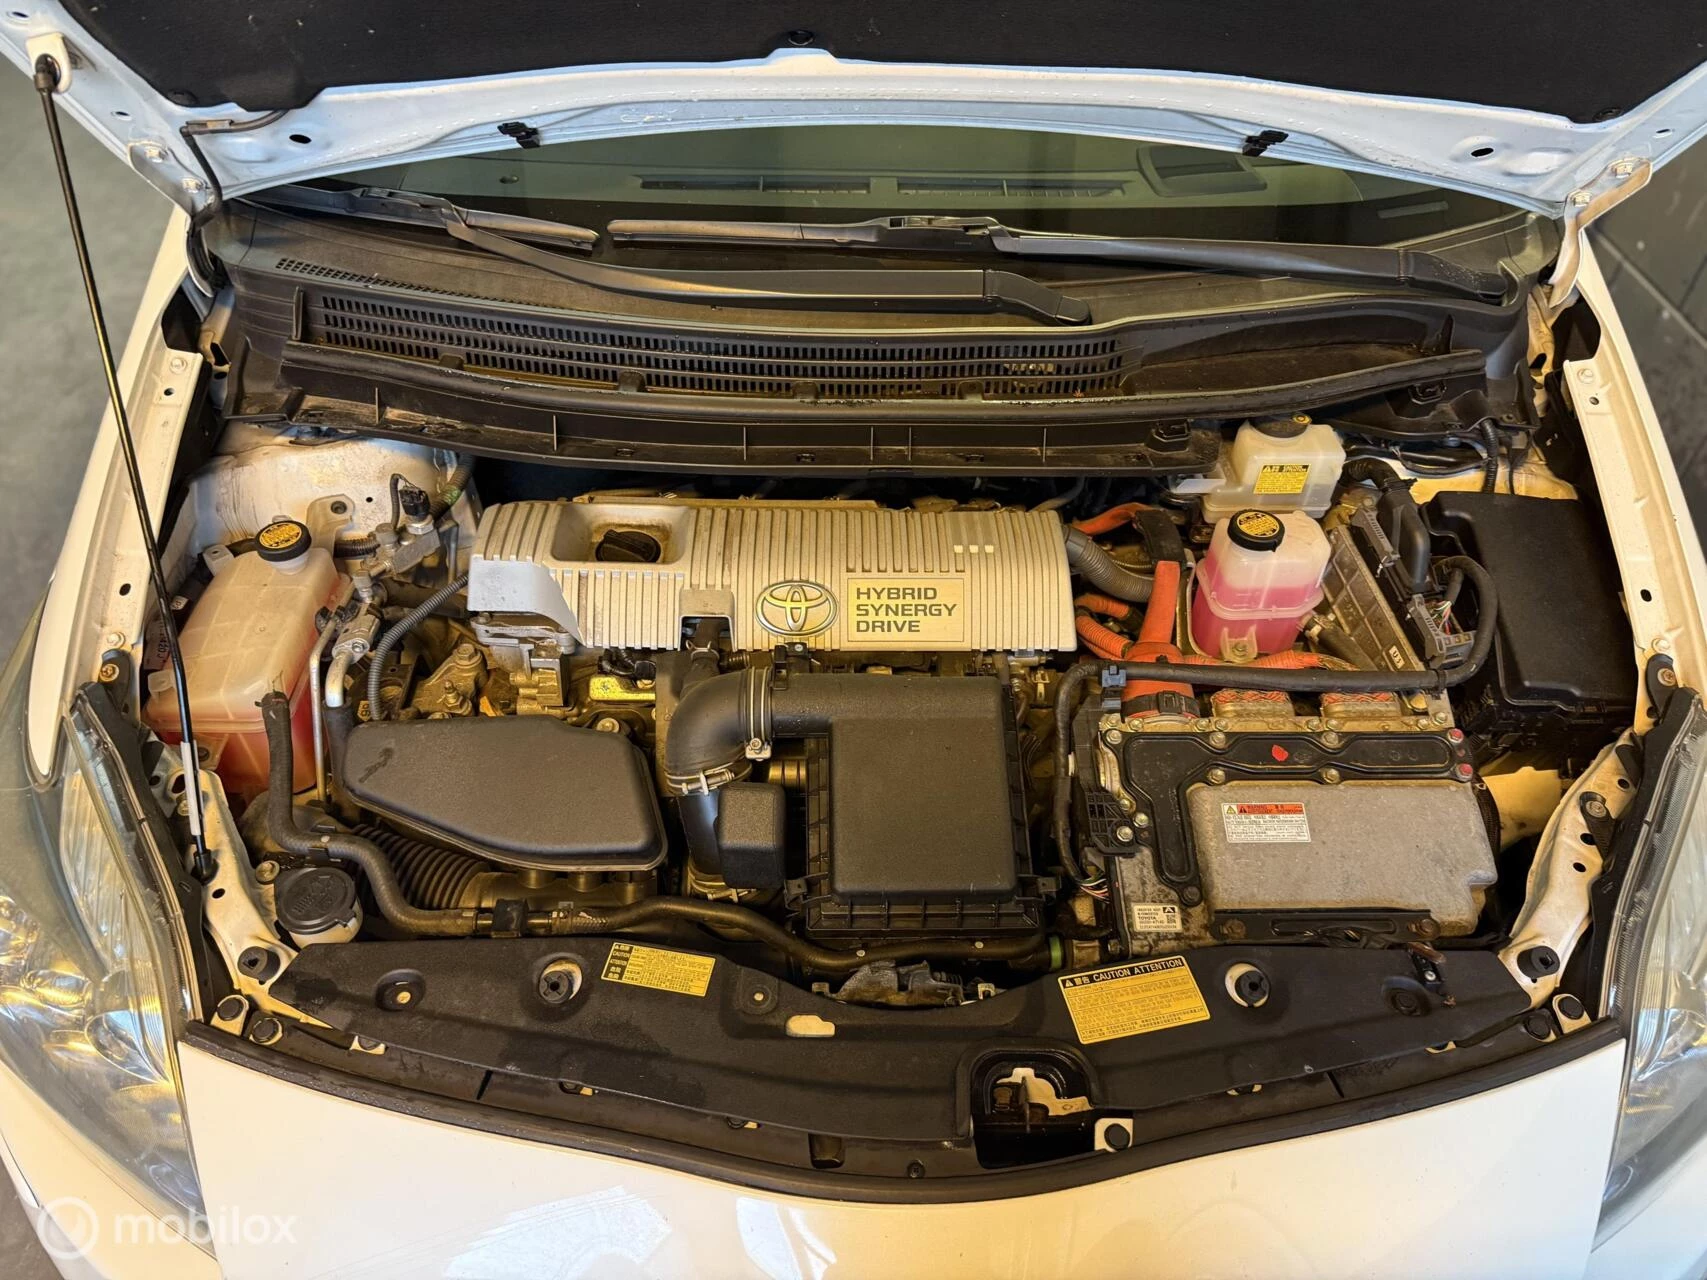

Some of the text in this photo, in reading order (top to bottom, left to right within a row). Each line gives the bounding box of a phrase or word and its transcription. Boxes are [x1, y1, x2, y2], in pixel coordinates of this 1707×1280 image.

[856, 587, 938, 600] HYBRID
[856, 603, 957, 617] SYNERGY
[856, 620, 921, 633] DRIVE
[1093, 968, 1131, 982] CAUTION
[1134, 958, 1183, 975] ATTENTION
